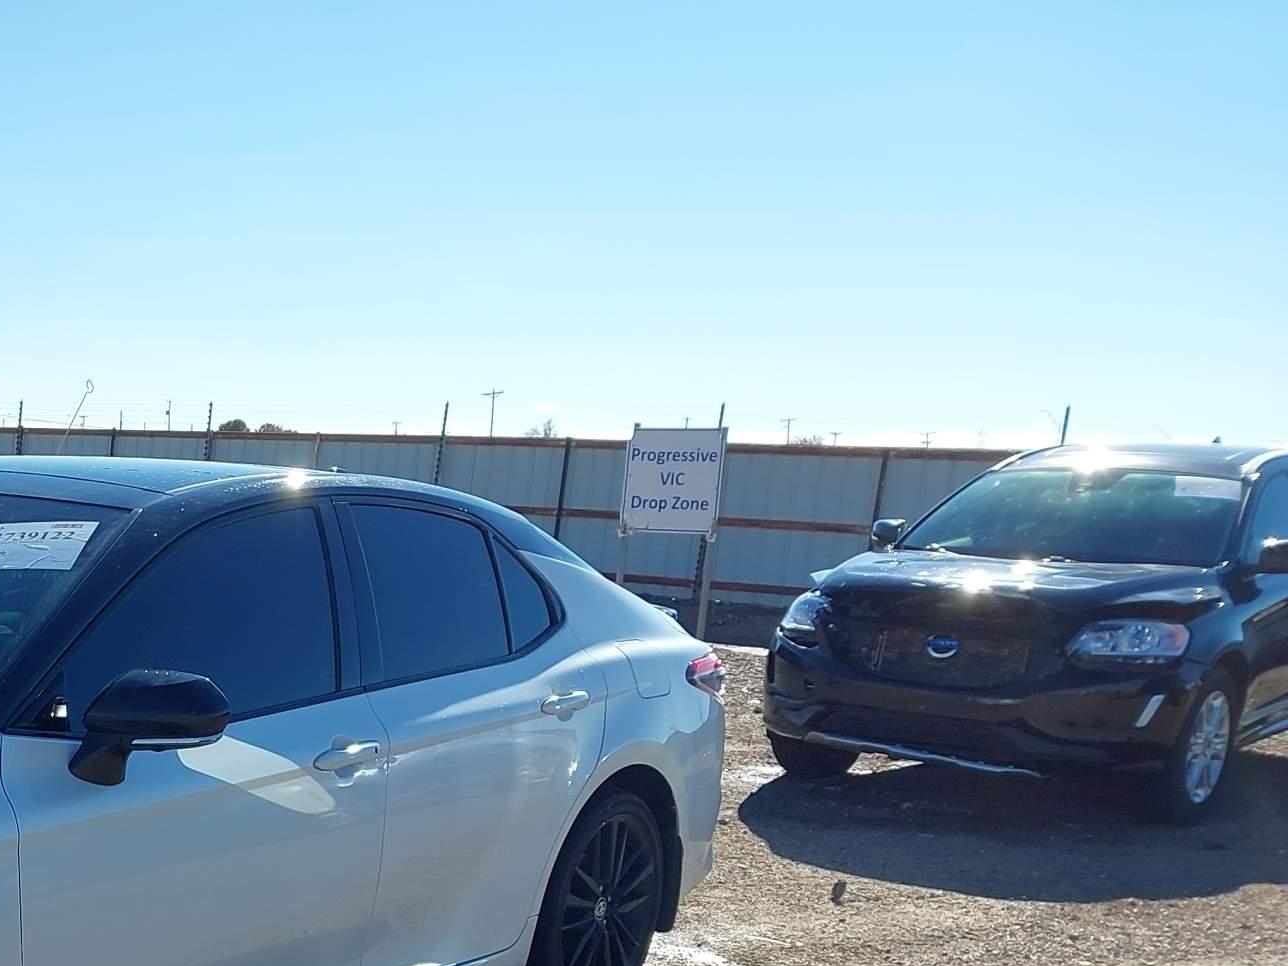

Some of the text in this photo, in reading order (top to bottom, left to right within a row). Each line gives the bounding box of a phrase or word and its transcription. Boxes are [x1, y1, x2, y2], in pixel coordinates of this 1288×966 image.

[631, 447, 718, 465] Progressive
[660, 472, 686, 486] VIC
[631, 495, 709, 512] Drop Zone
